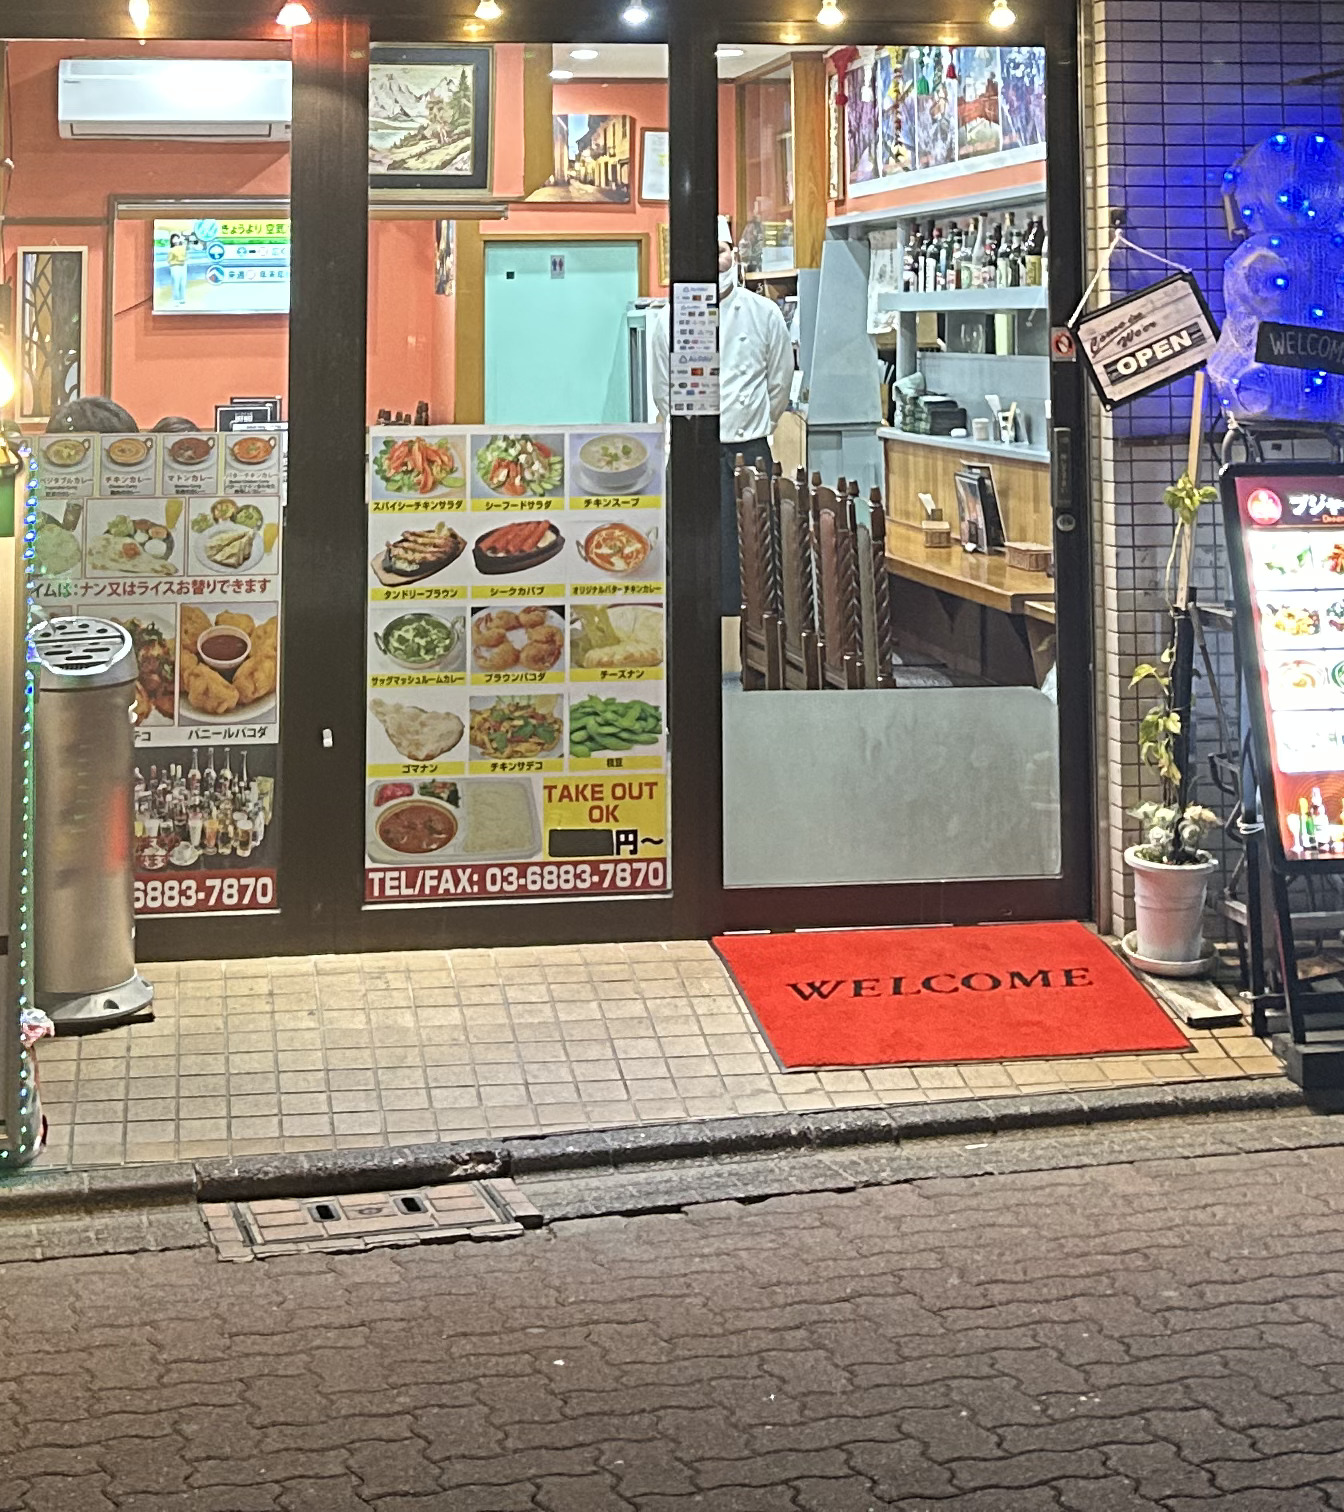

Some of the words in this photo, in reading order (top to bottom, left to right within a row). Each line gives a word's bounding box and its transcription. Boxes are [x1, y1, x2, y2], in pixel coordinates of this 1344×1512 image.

[1116, 329, 1193, 376] OPEN
[105, 475, 153, 484] チキンカレー
[167, 474, 214, 482] マトンカレー
[373, 499, 463, 512] スパイシーチキンサラダ
[485, 499, 552, 511] シーフードサラダ
[583, 497, 640, 509] チキンスープ
[599, 669, 645, 680] チーズナン
[401, 763, 438, 774] ゴマナン
[490, 761, 543, 772] チキンサデコ
[543, 783, 605, 804] TAKE
[610, 781, 658, 801] OUT
[588, 804, 620, 824] OK
[368, 867, 479, 897] TEL/FAX:
[485, 861, 664, 892] 03-6883-7870
[784, 966, 1095, 1002] WELCOME
